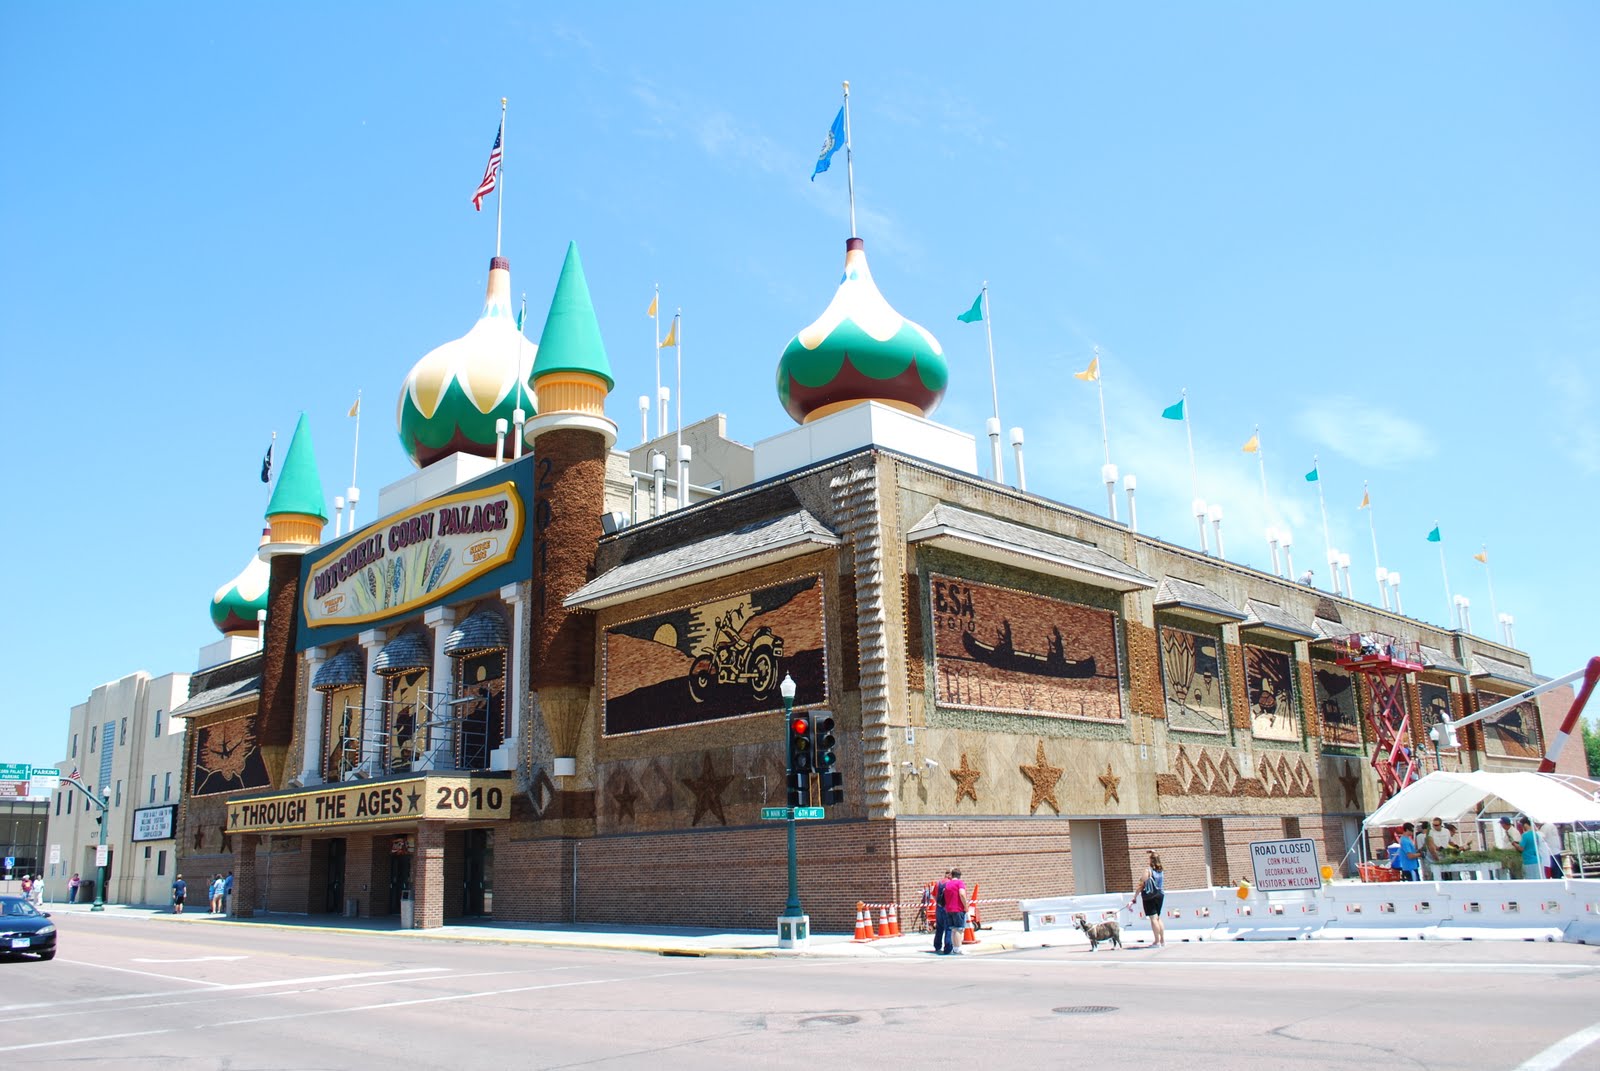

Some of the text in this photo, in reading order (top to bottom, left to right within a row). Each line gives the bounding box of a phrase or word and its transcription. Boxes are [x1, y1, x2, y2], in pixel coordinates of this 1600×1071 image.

[314, 500, 508, 600] MITCHELL CORN PALACE
[935, 581, 975, 618] ESA
[242, 786, 403, 827] THROUGH THE AGES
[436, 786, 503, 810] 2010
[1255, 843, 1311, 855] ROAD CLOSED
[1267, 856, 1300, 865] CORN PALACE
[1264, 866, 1308, 876] DECORATING AREA
[1258, 877, 1319, 888] VISITORS WELCOME
